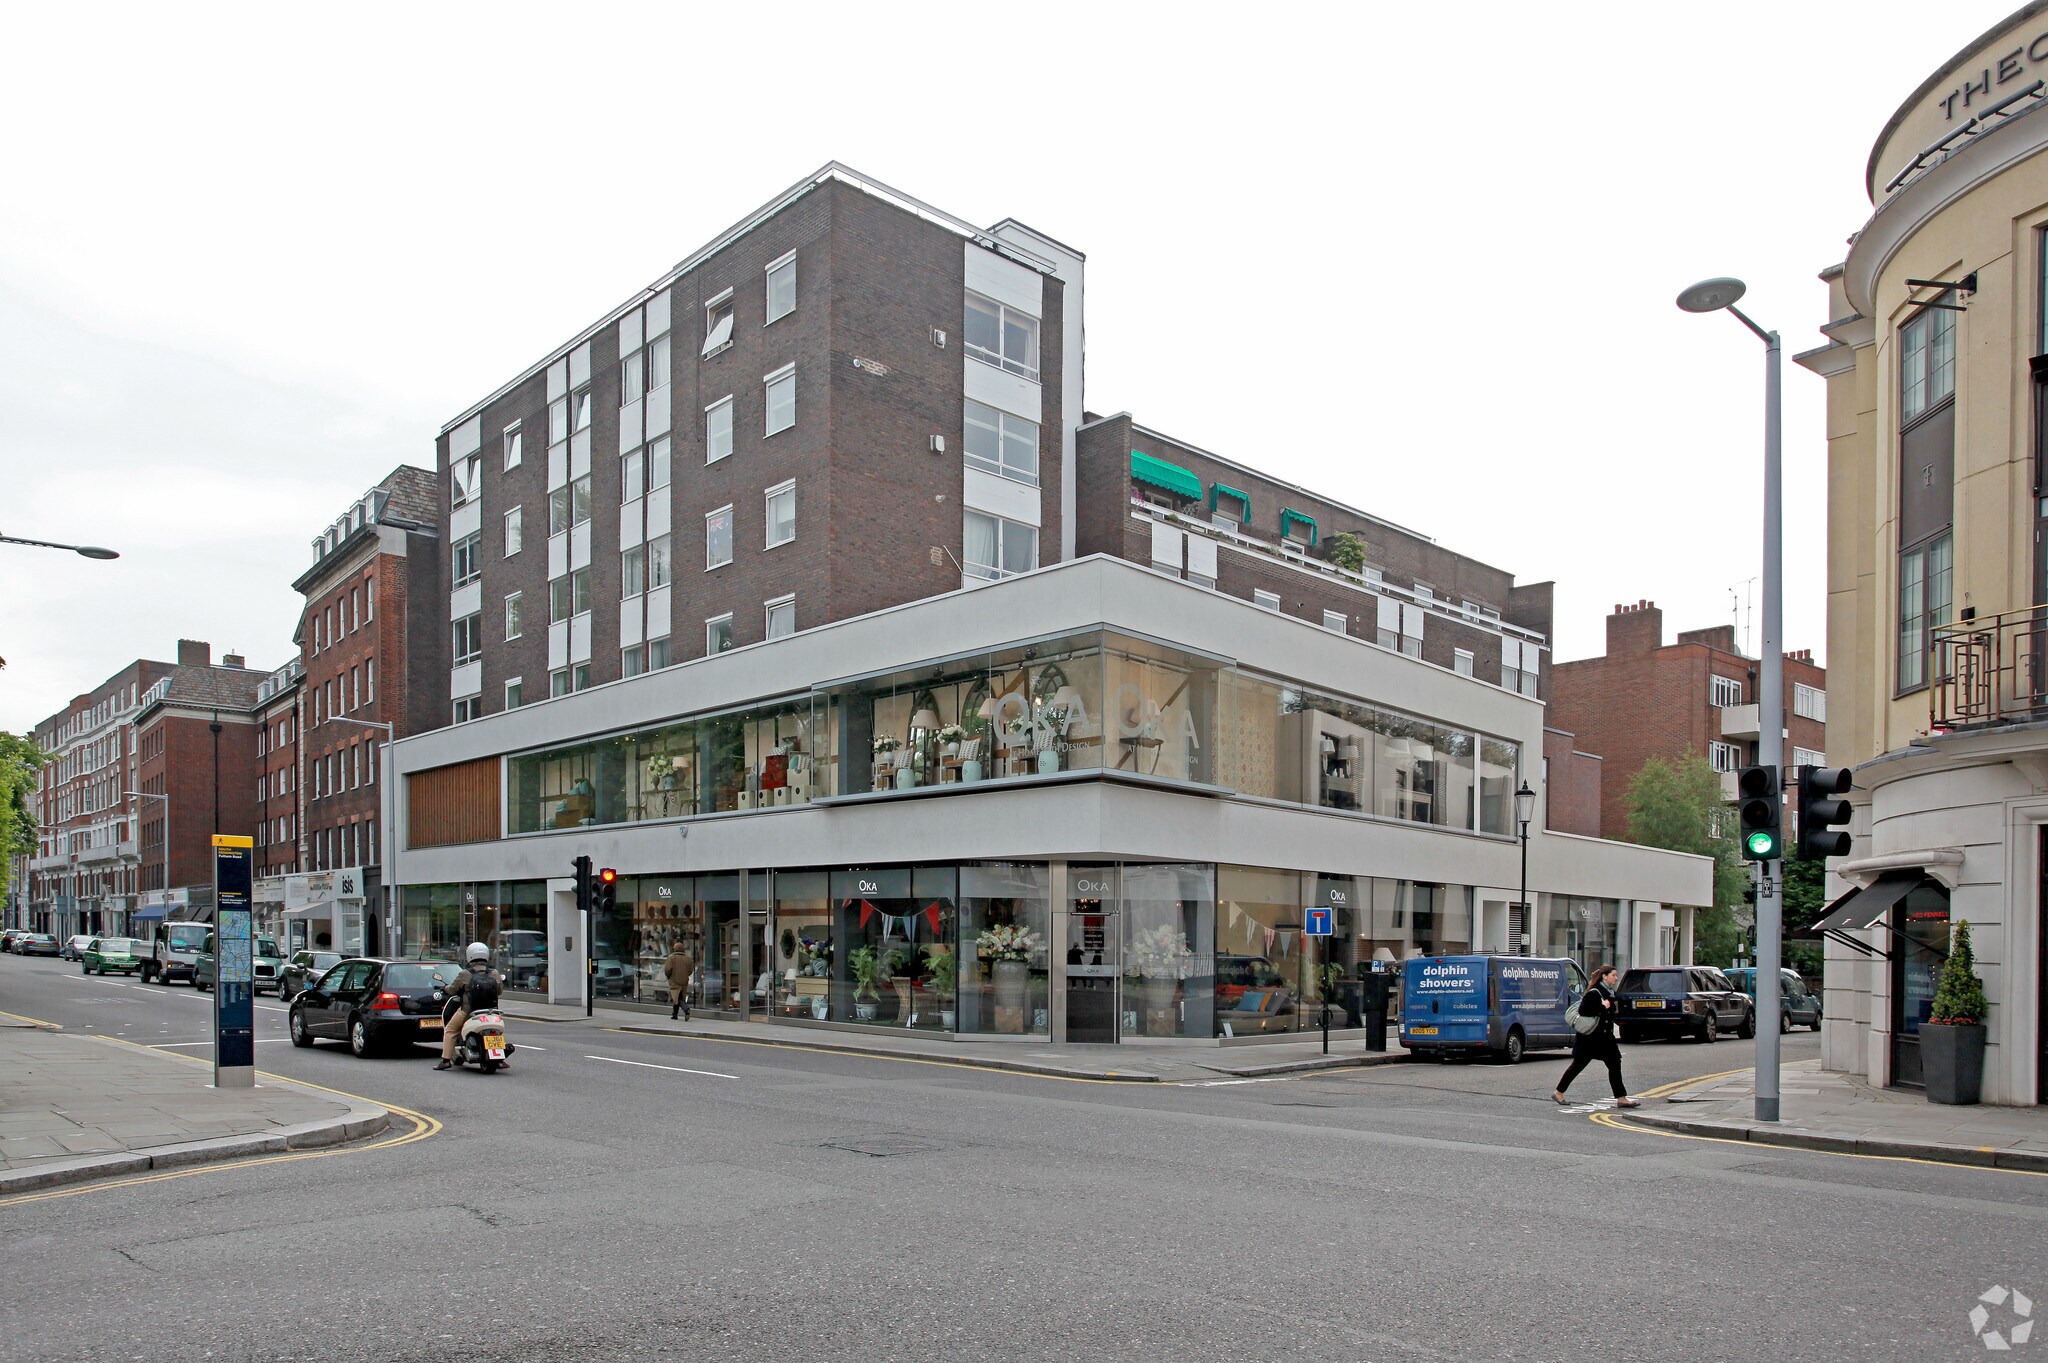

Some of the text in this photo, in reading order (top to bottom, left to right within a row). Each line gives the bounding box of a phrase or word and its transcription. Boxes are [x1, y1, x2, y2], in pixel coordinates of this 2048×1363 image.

[993, 692, 1092, 745] OKA
[1062, 740, 1090, 753] DESIGN
[342, 875, 354, 894] isis
[858, 879, 878, 891] OKA
[1077, 879, 1110, 891] OKA
[1330, 889, 1346, 901] OKA
[1423, 965, 1468, 977] dolphin
[1502, 966, 1530, 980] dolphin
